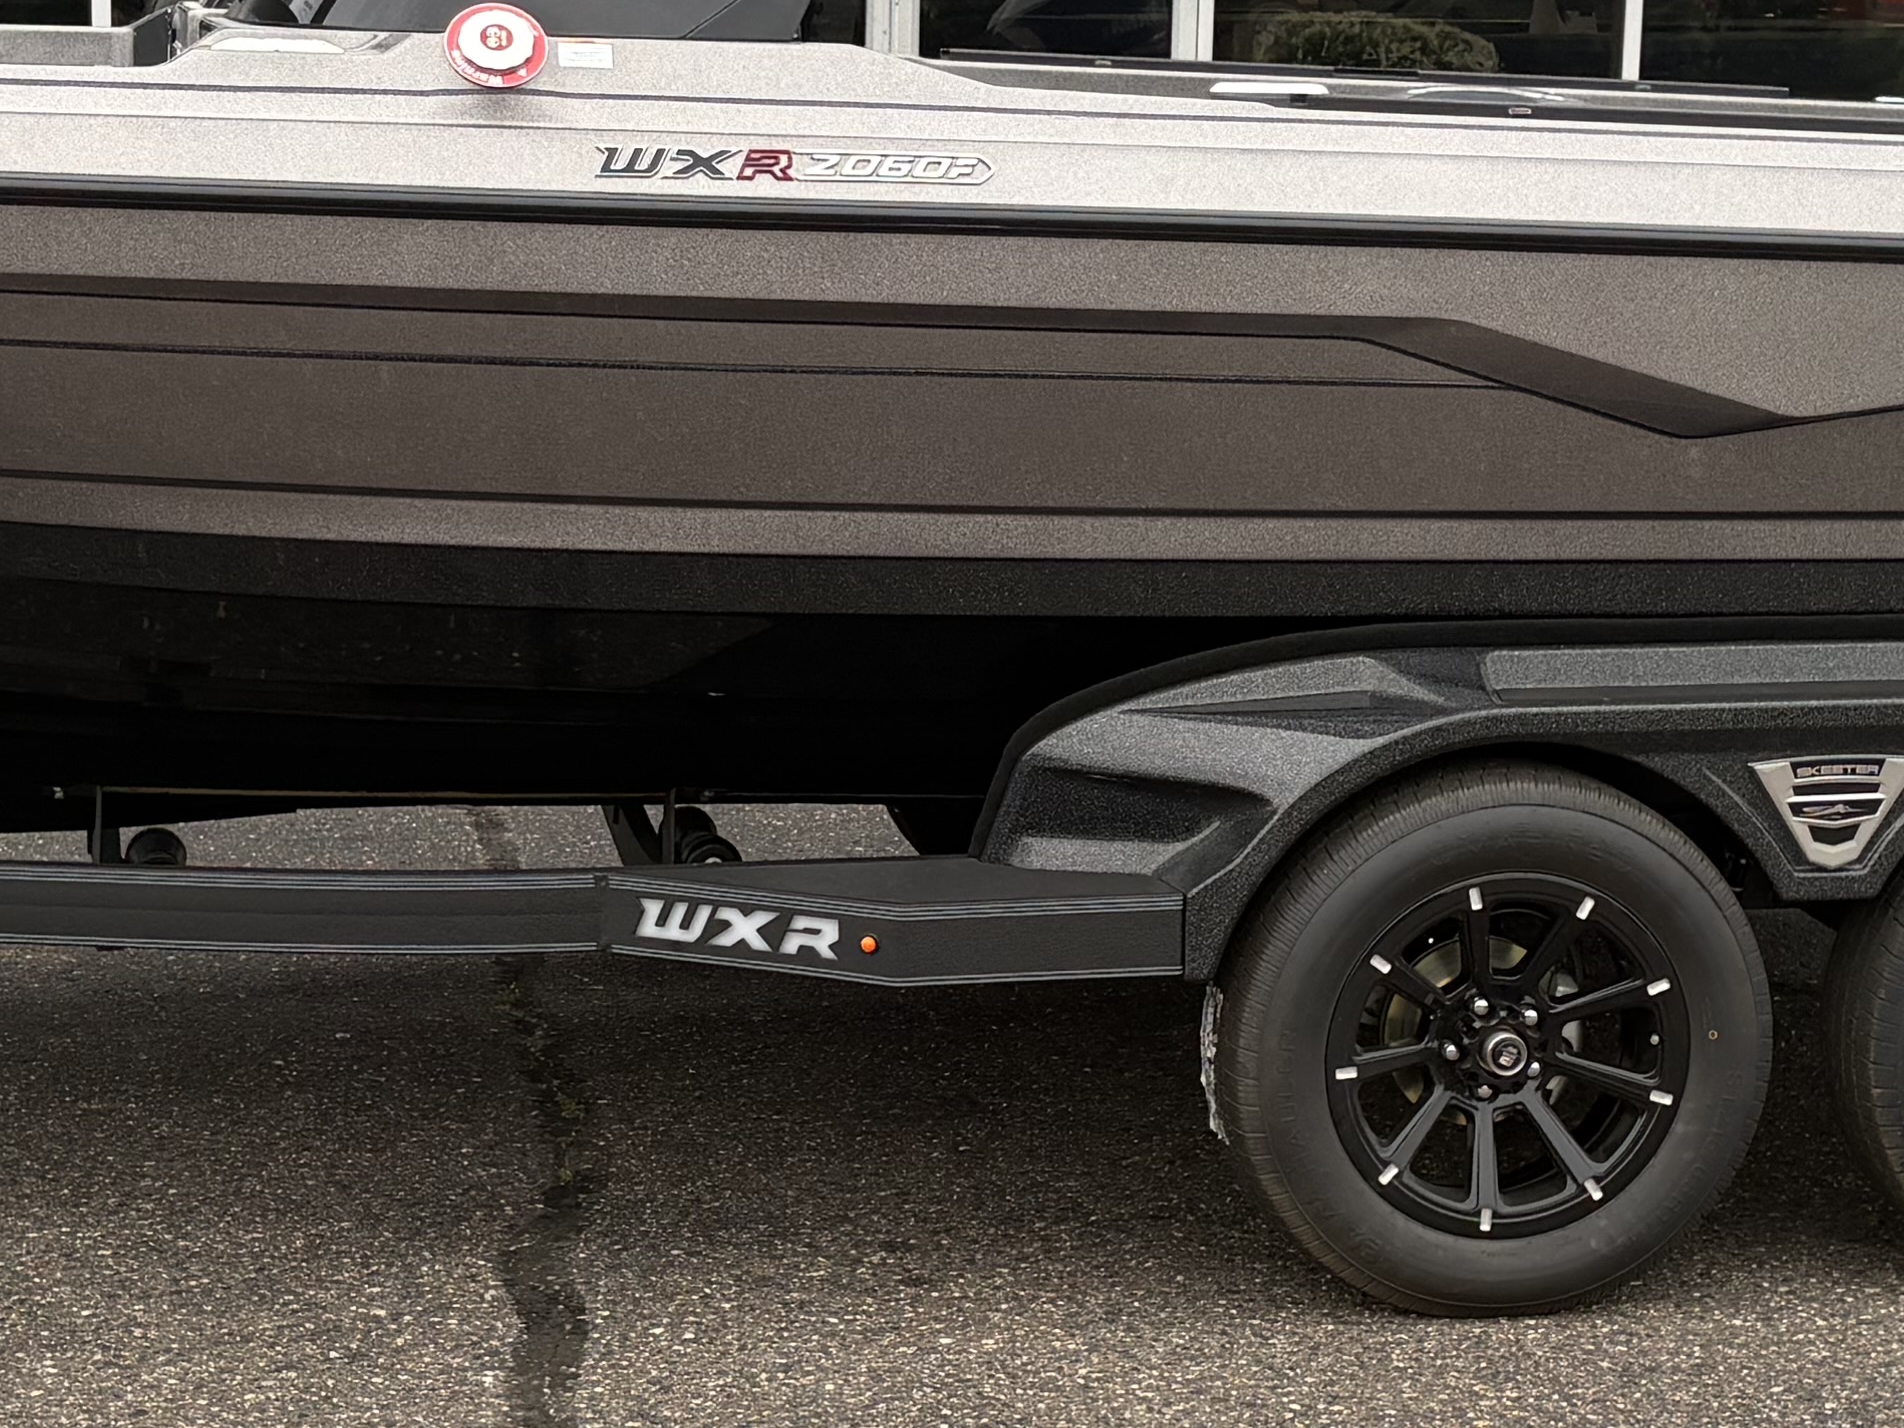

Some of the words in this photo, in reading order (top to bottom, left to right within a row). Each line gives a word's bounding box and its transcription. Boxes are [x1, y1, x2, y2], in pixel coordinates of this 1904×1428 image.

[593, 144, 796, 182] WXR
[1796, 764, 1880, 778] SKEETER
[634, 897, 841, 961] WXR
